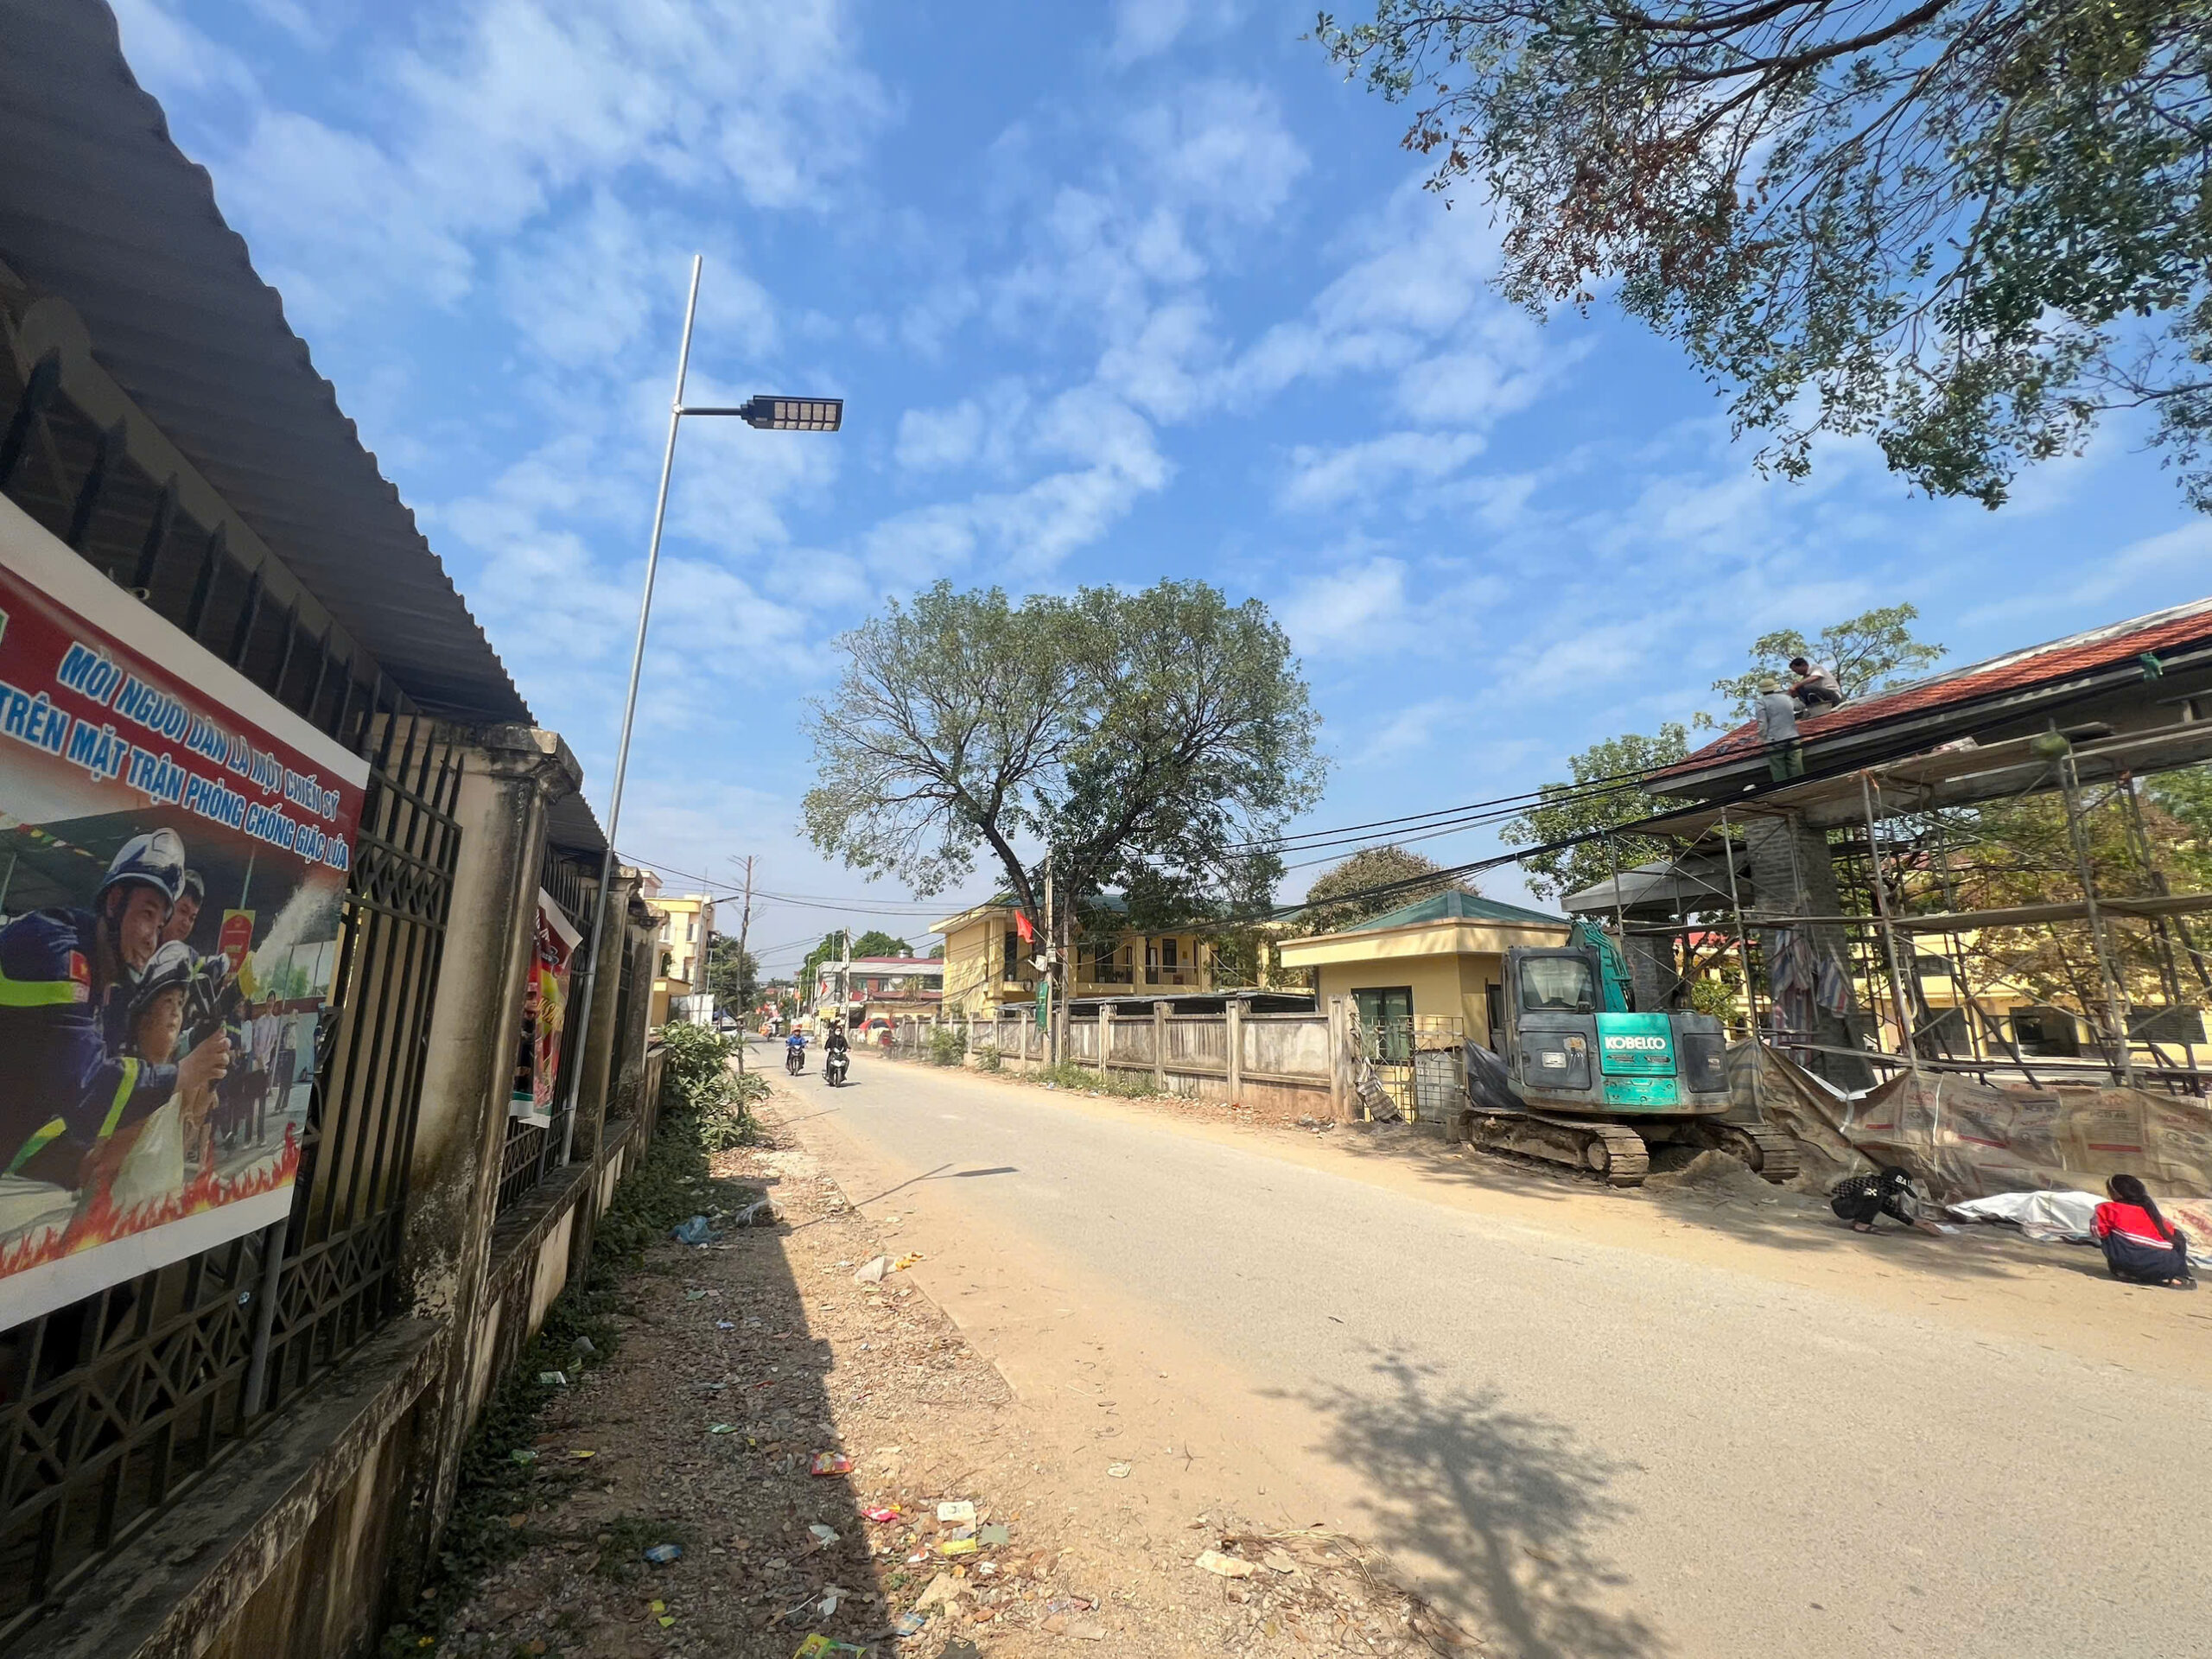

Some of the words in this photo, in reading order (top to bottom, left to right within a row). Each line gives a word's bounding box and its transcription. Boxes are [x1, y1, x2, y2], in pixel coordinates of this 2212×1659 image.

[0, 680, 70, 756] TRÊN
[66, 719, 129, 782] MẶT
[126, 746, 186, 805] TRẬN
[182, 772, 245, 830] PHÒNG
[244, 804, 296, 849] CHỐNG
[295, 825, 326, 864] GIẶC
[325, 833, 349, 871] LỬA
[185, 713, 228, 764] DÂN
[226, 735, 251, 778] LÀ
[251, 749, 283, 795] MỘT
[284, 768, 321, 814] CHIẾN
[322, 790, 340, 822] SỸ
[1605, 1037, 1666, 1049] KOBELCO
